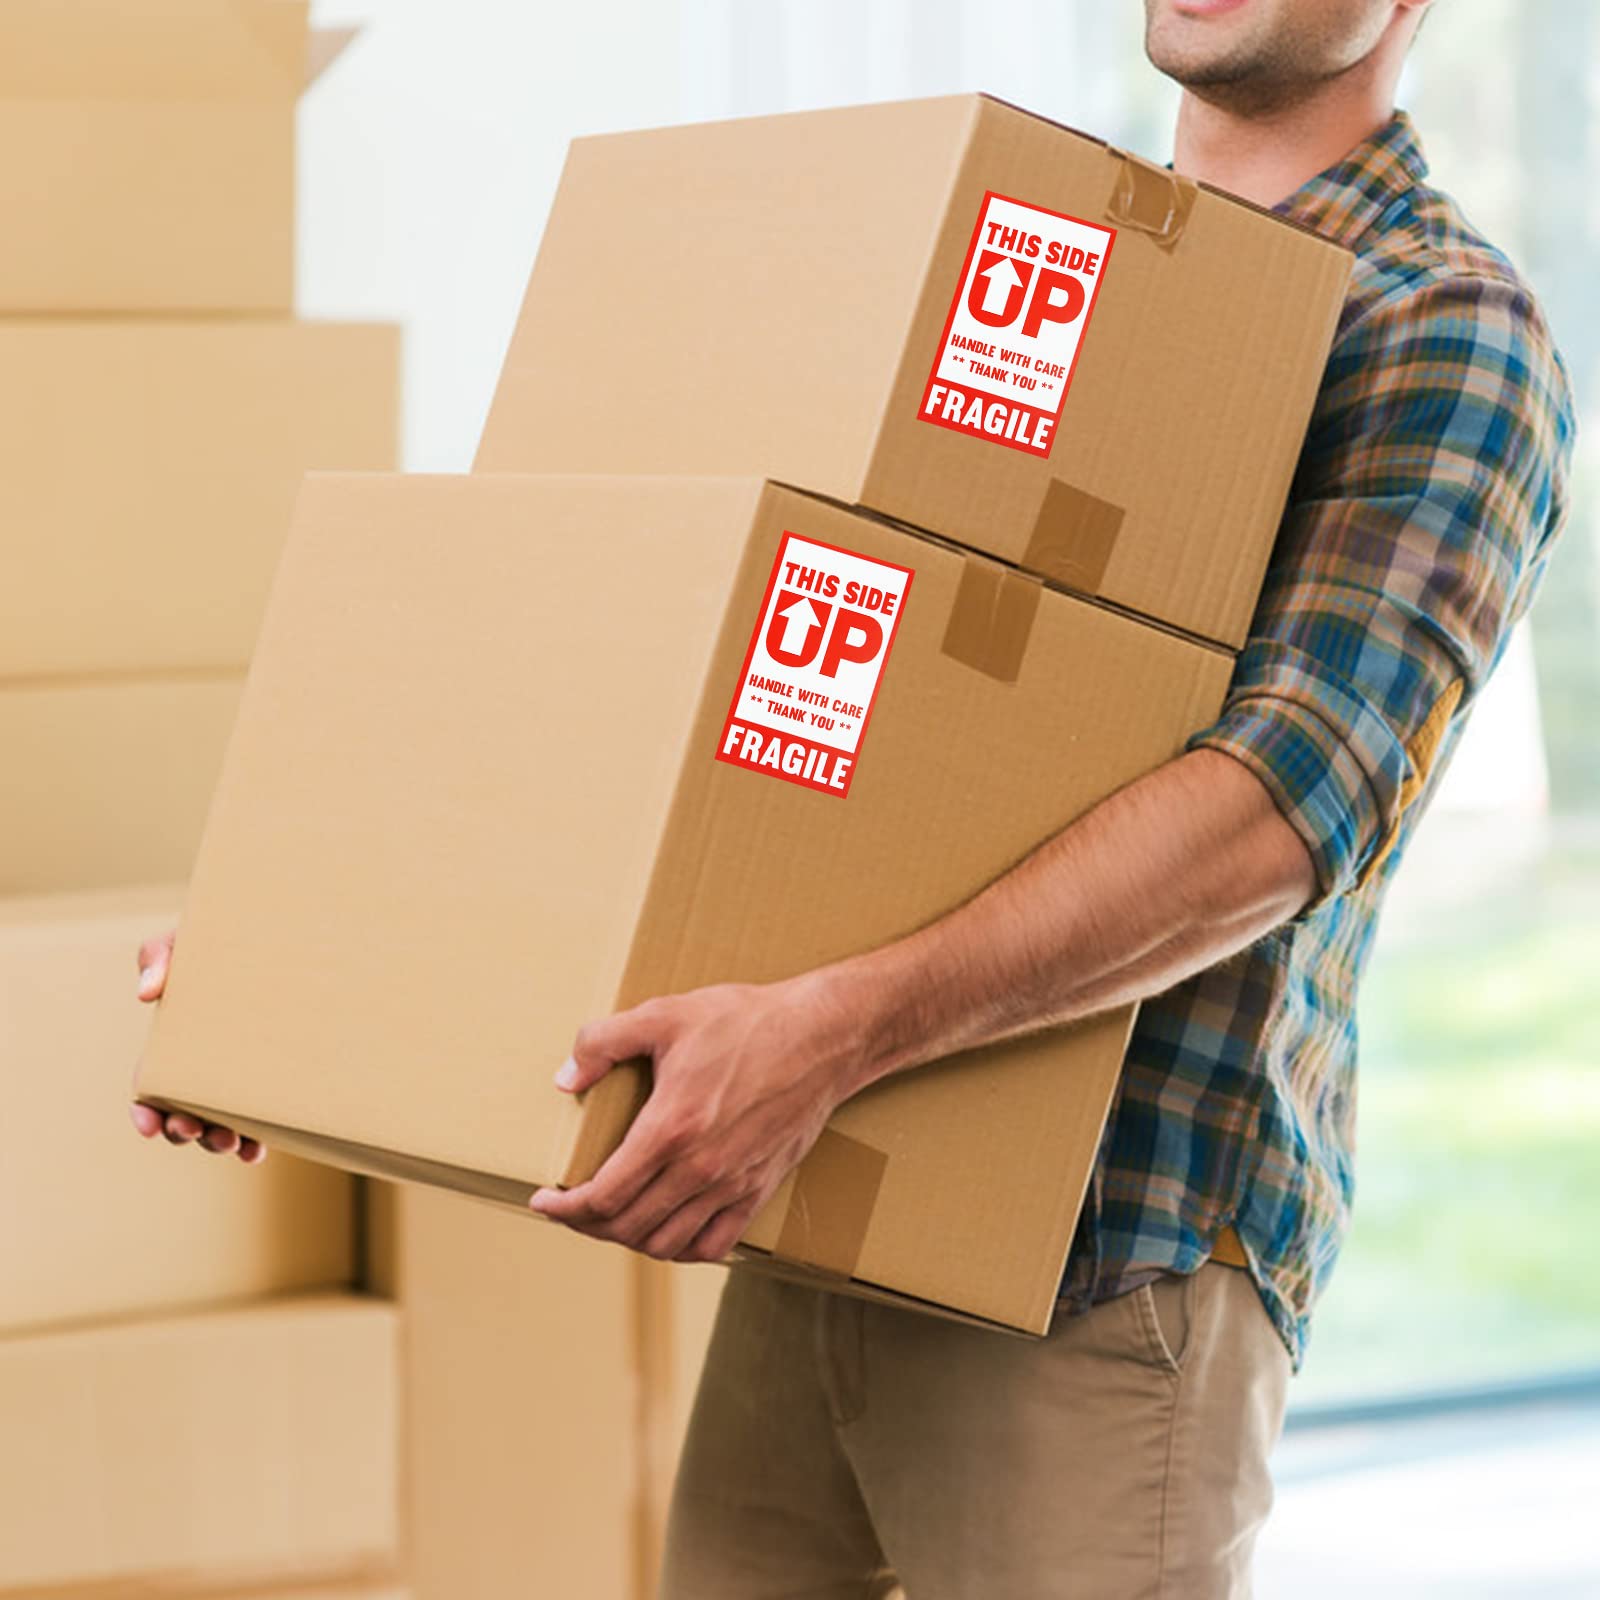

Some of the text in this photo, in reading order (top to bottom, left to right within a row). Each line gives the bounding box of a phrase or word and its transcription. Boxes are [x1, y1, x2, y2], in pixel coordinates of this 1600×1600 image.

[987, 221, 1099, 276] THIS SIDE
[967, 249, 1085, 338] UP
[950, 333, 1065, 379] HANDLE WITH CARE
[969, 359, 1037, 391] THANK YOU
[924, 383, 1054, 450] FRAGILE
[785, 561, 897, 616] THIS SIDE
[765, 589, 883, 679] UP
[748, 673, 863, 719] HANDLE WITH CARE
[767, 699, 835, 731] THANK YOU
[722, 723, 852, 790] FRAGILE
